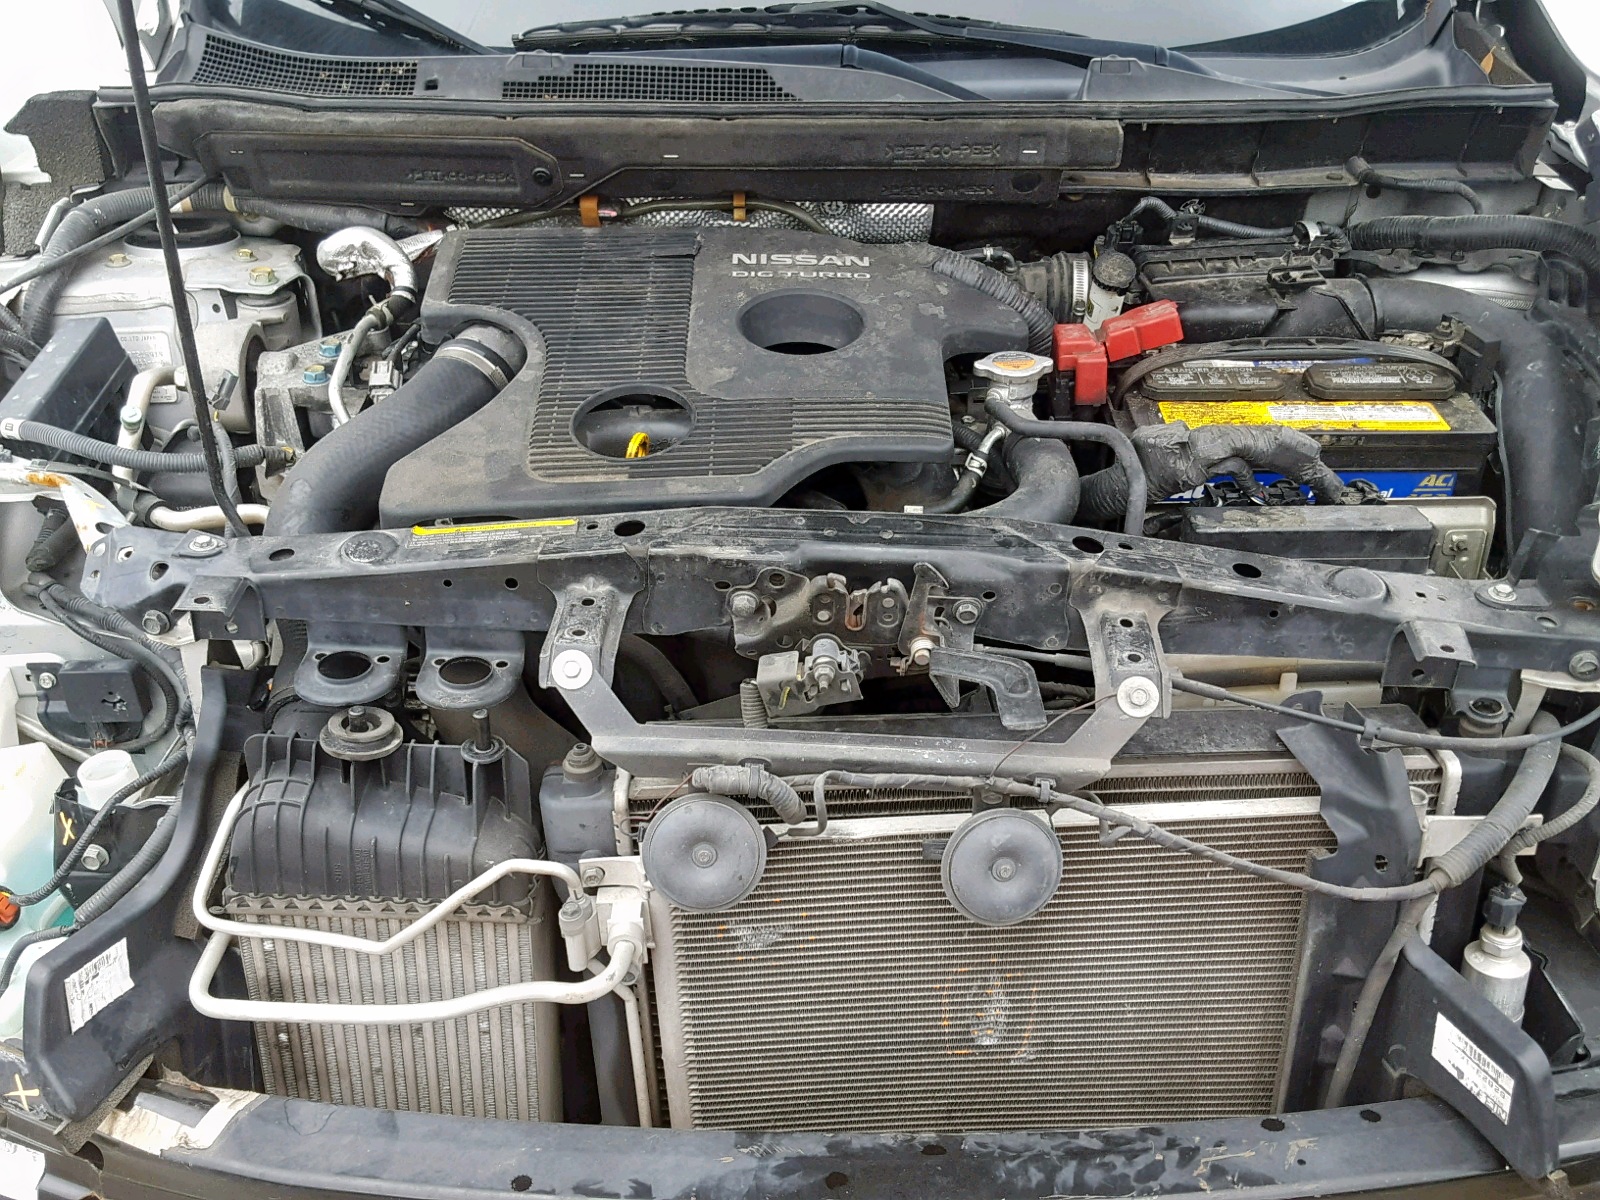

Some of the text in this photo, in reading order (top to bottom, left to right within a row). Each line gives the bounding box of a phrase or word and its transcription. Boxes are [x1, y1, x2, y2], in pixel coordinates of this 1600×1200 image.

[731, 252, 871, 267] NISSAN
[731, 270, 871, 279] DIG TURBO
